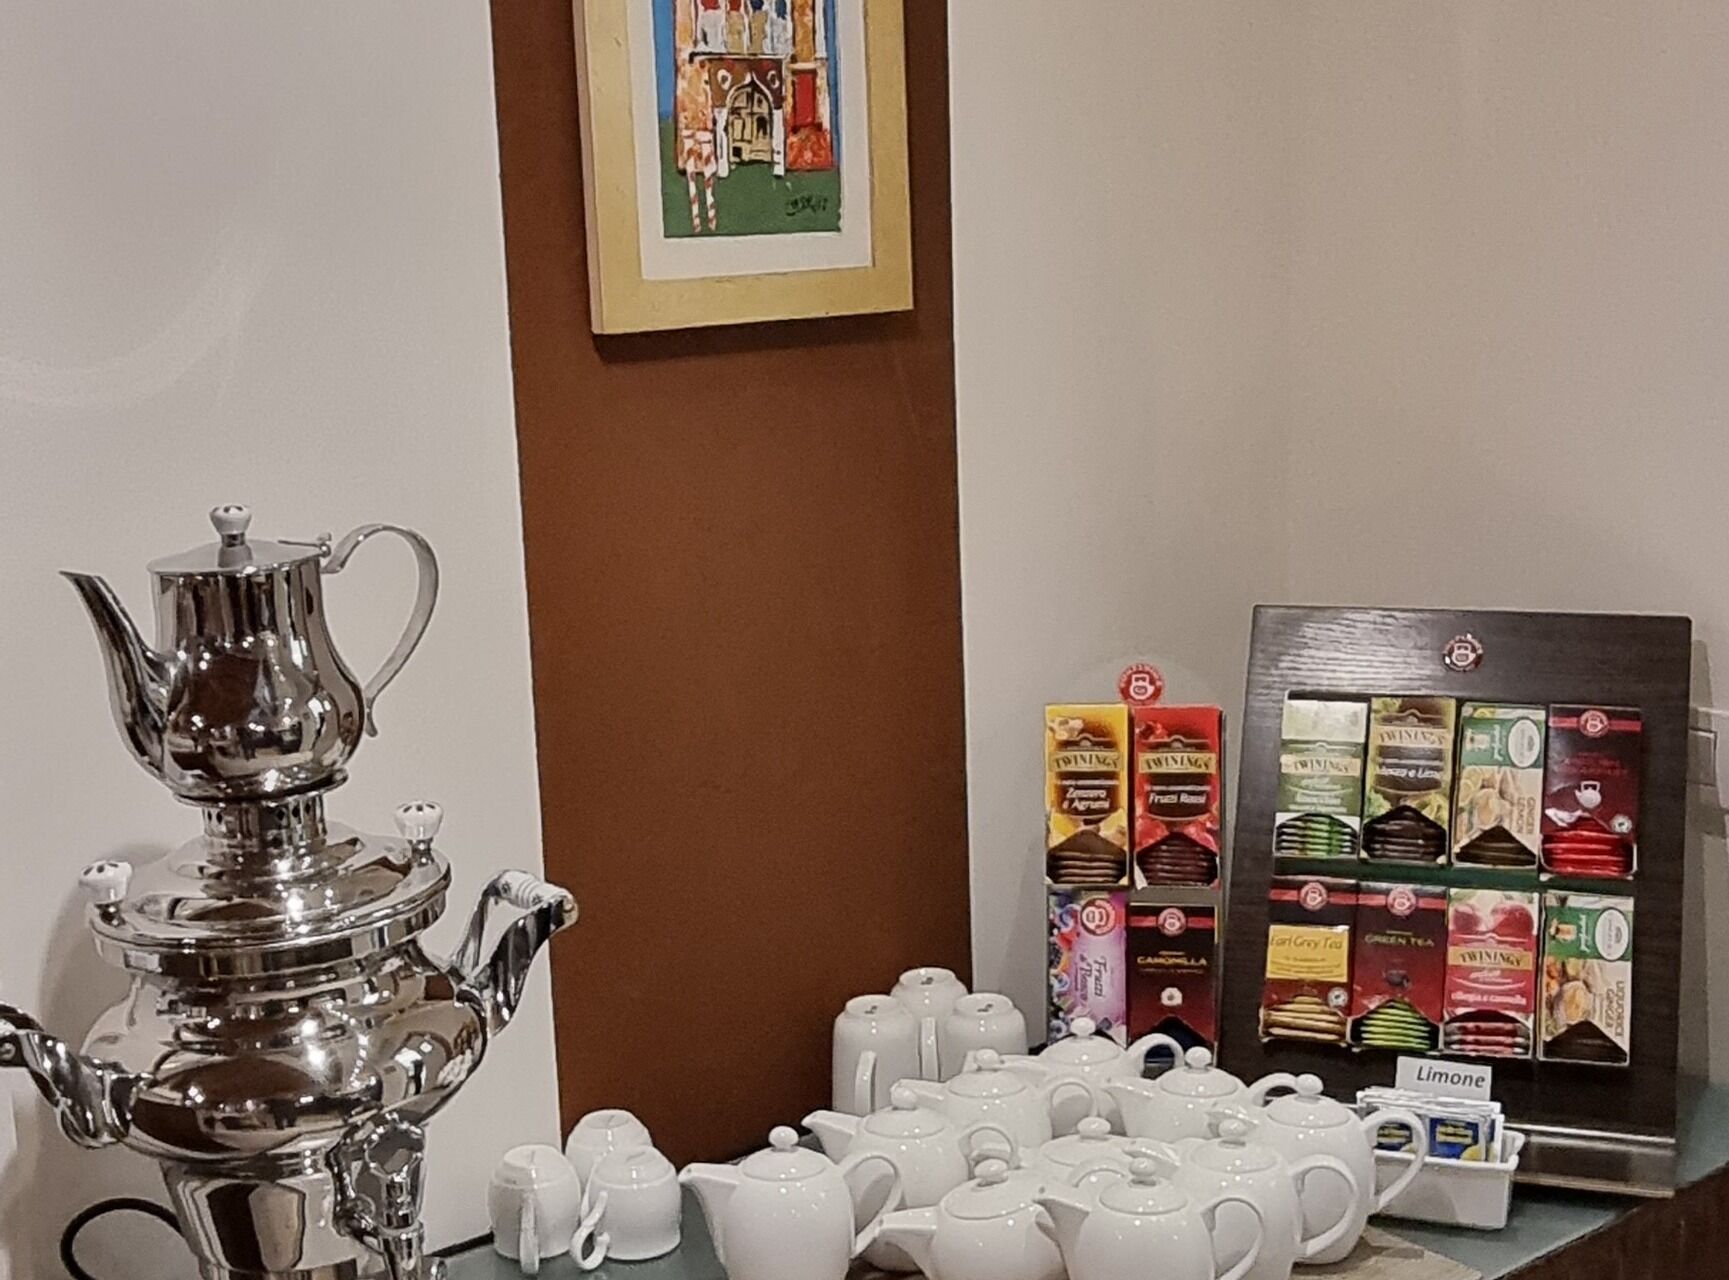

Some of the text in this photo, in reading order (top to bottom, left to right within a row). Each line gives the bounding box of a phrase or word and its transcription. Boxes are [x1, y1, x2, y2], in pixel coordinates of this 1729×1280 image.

[1379, 730, 1447, 745] TWININGS
[1055, 754, 1119, 769] TWININGS
[1145, 755, 1210, 771] TWININGS
[1293, 758, 1349, 773] TWININGS
[1270, 935, 1343, 950] Earl Grey Tea
[1364, 933, 1436, 948] GREEN TEA
[1136, 956, 1208, 967] CAMOMILLA
[1459, 950, 1522, 967] TWININGS
[1604, 988, 1615, 1029] GINGER
[1614, 980, 1626, 1037] LIQUORICE
[1416, 1065, 1487, 1089] Limone
